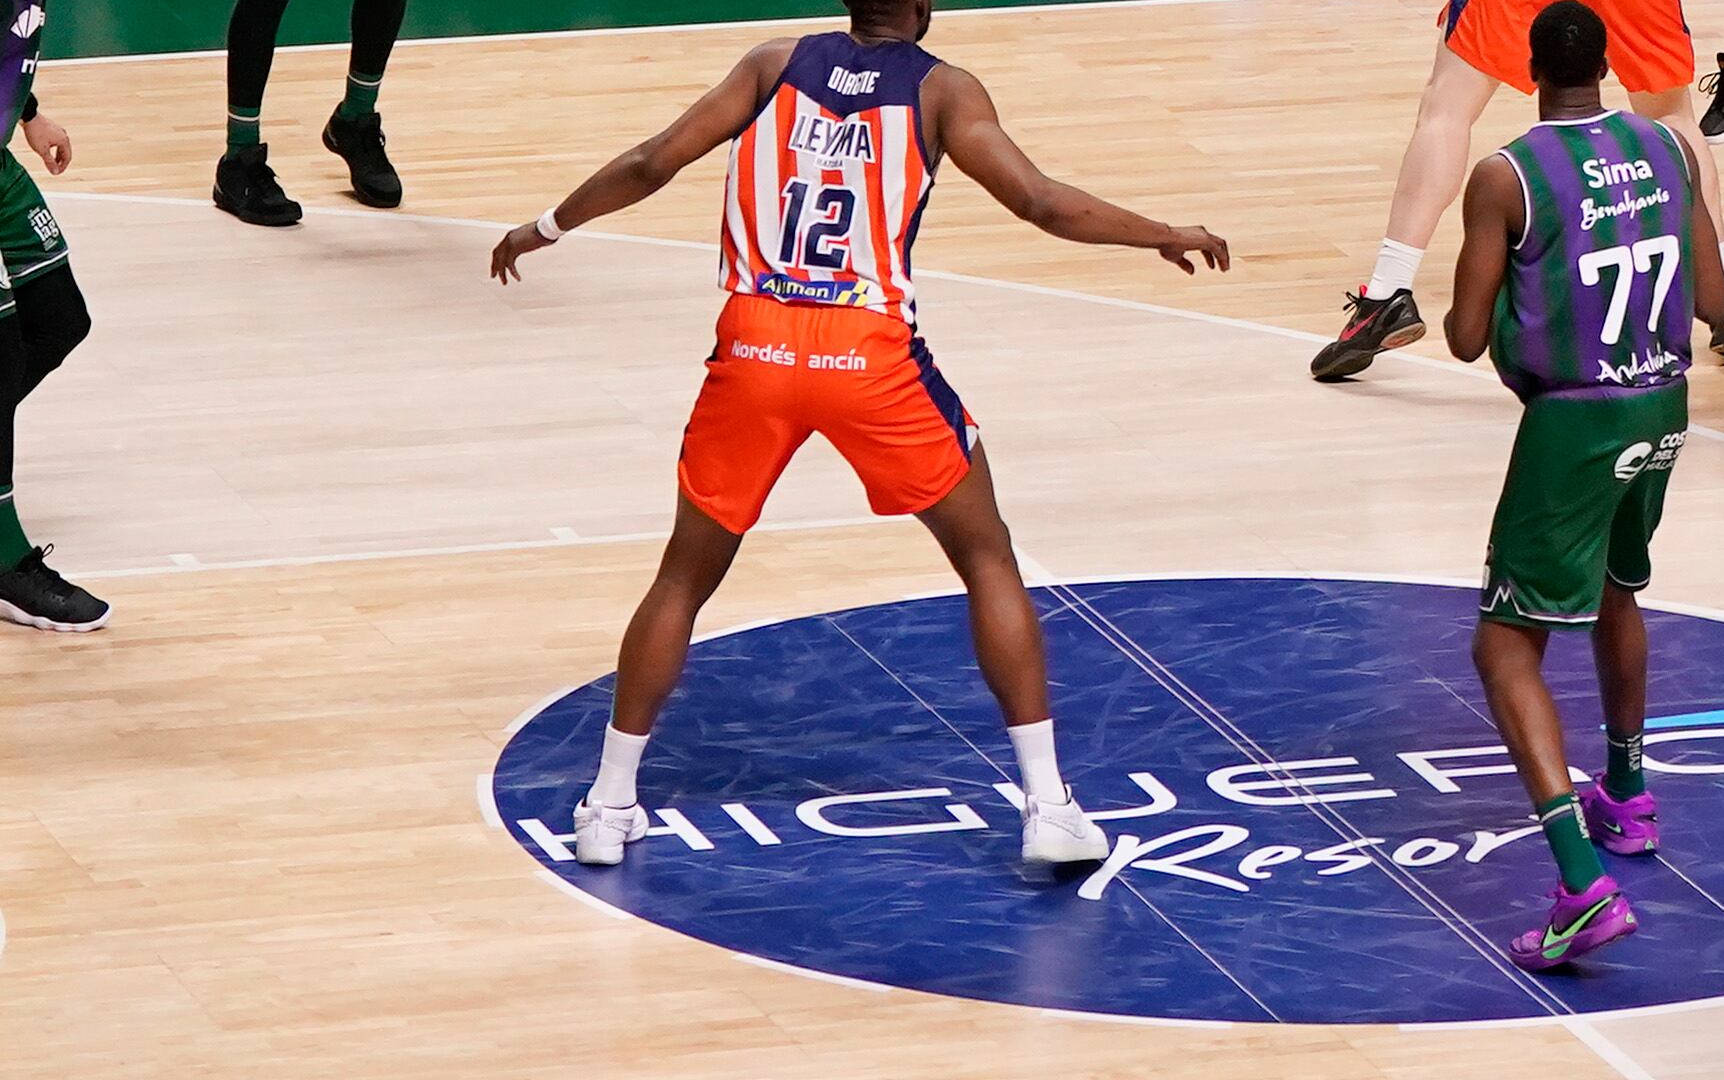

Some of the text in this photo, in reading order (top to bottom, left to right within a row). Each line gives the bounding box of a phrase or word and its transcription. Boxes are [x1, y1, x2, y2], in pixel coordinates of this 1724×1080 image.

[791, 116, 872, 159] LEYMA
[1582, 157, 1654, 189] Sima
[780, 181, 856, 269] 12
[1578, 234, 1680, 345] 77
[732, 339, 867, 370] Nordés ancín
[1076, 813, 1545, 901] Resor
